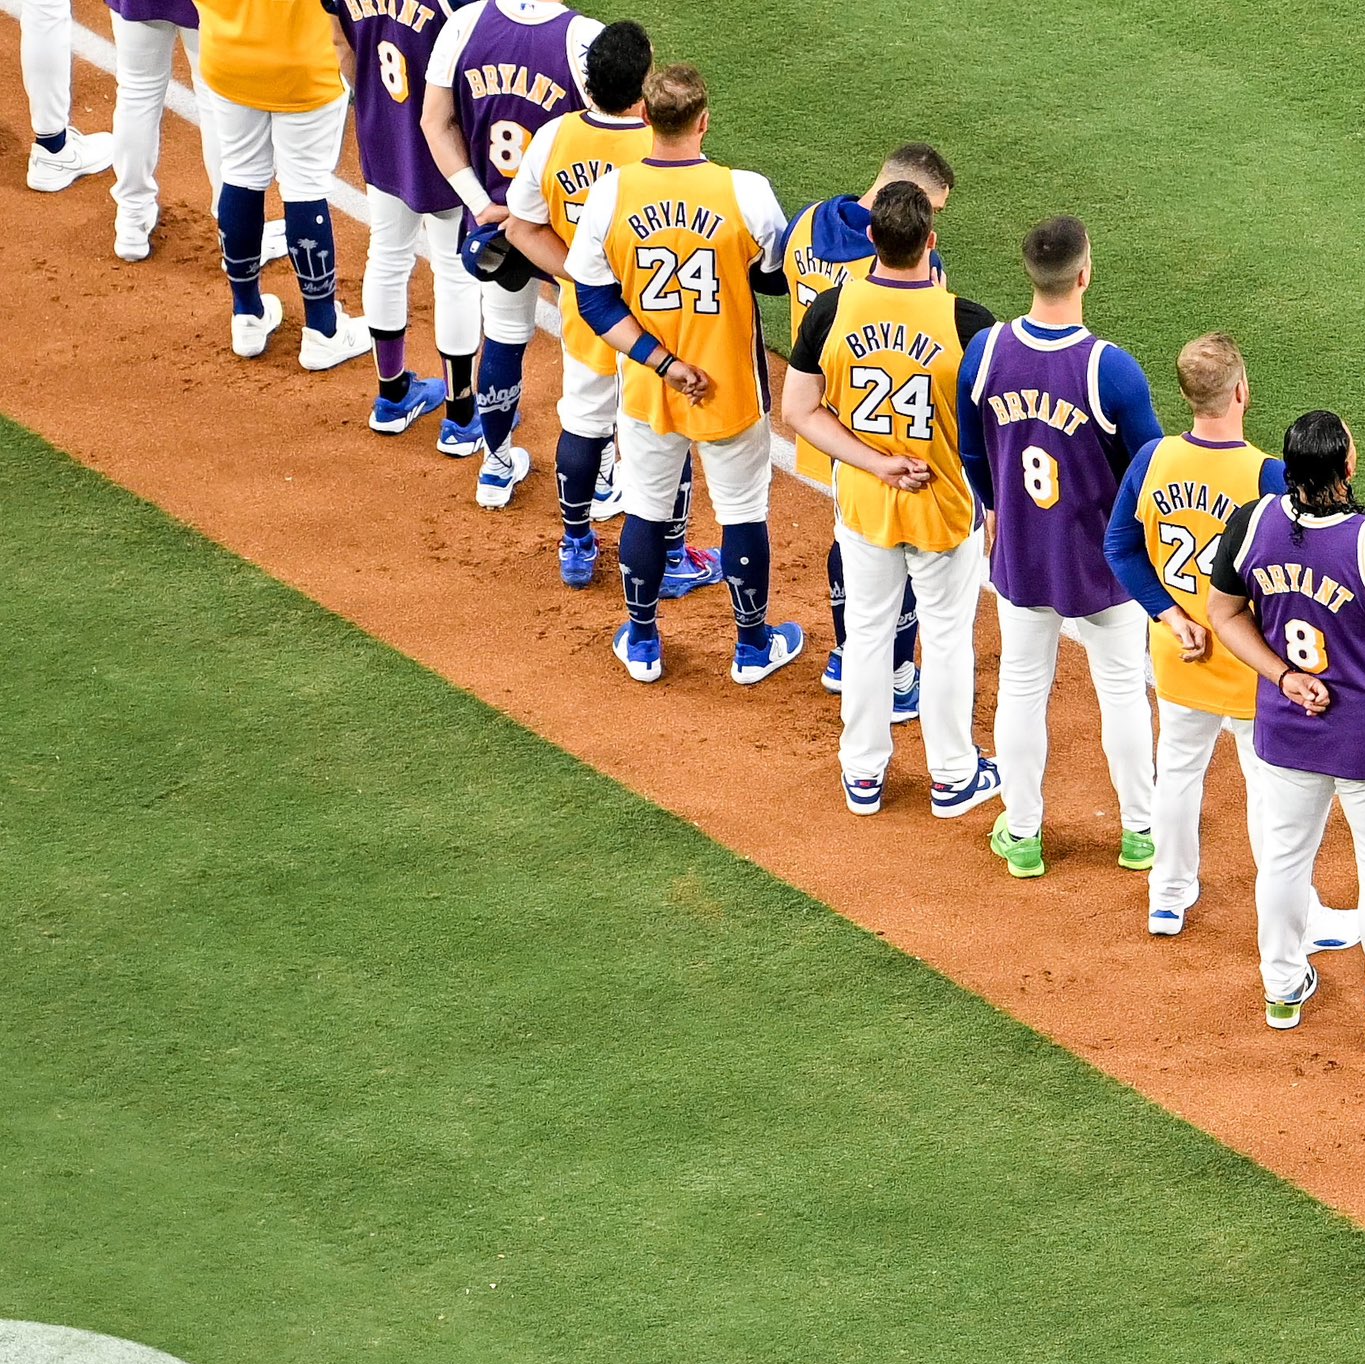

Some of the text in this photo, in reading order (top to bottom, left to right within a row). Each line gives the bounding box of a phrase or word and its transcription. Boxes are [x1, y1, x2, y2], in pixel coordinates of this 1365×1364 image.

[377, 40, 409, 103] 8
[464, 63, 567, 112] BRYANT
[489, 120, 532, 178] 8
[555, 160, 613, 195] BRY
[627, 200, 724, 241] BRYANT
[635, 246, 720, 315] 24
[845, 322, 942, 367] BRYANT
[850, 365, 934, 440] 24
[988, 389, 1090, 436] BRYANT
[1022, 445, 1059, 509] 8
[1252, 563, 1355, 614] BRYANT
[1285, 619, 1328, 674] 8
